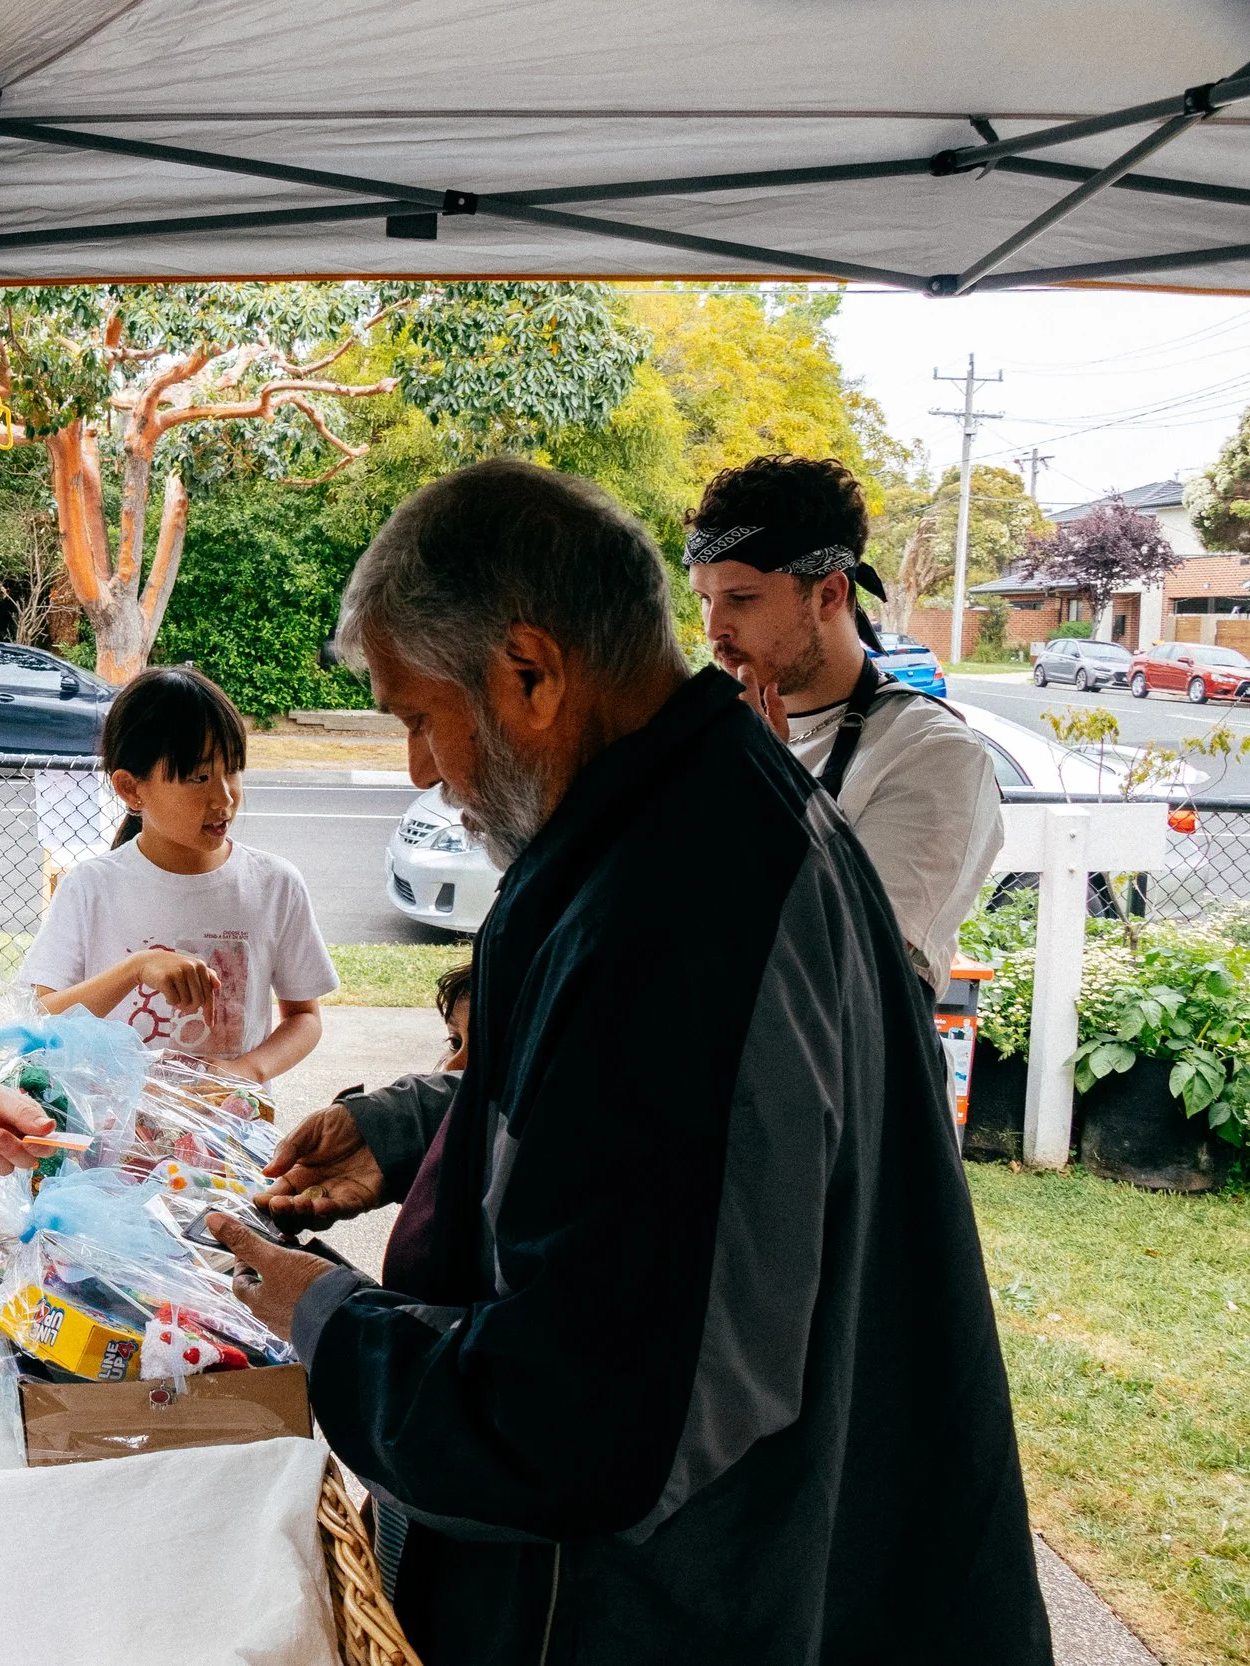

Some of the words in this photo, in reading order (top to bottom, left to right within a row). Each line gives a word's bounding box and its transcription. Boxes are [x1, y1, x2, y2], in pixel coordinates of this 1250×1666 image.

[44, 1309, 64, 1329] UP
[29, 1323, 58, 1347] LINE
[99, 1341, 119, 1380] LINE
[117, 1341, 136, 1359] 4
[109, 1357, 126, 1381] UP
